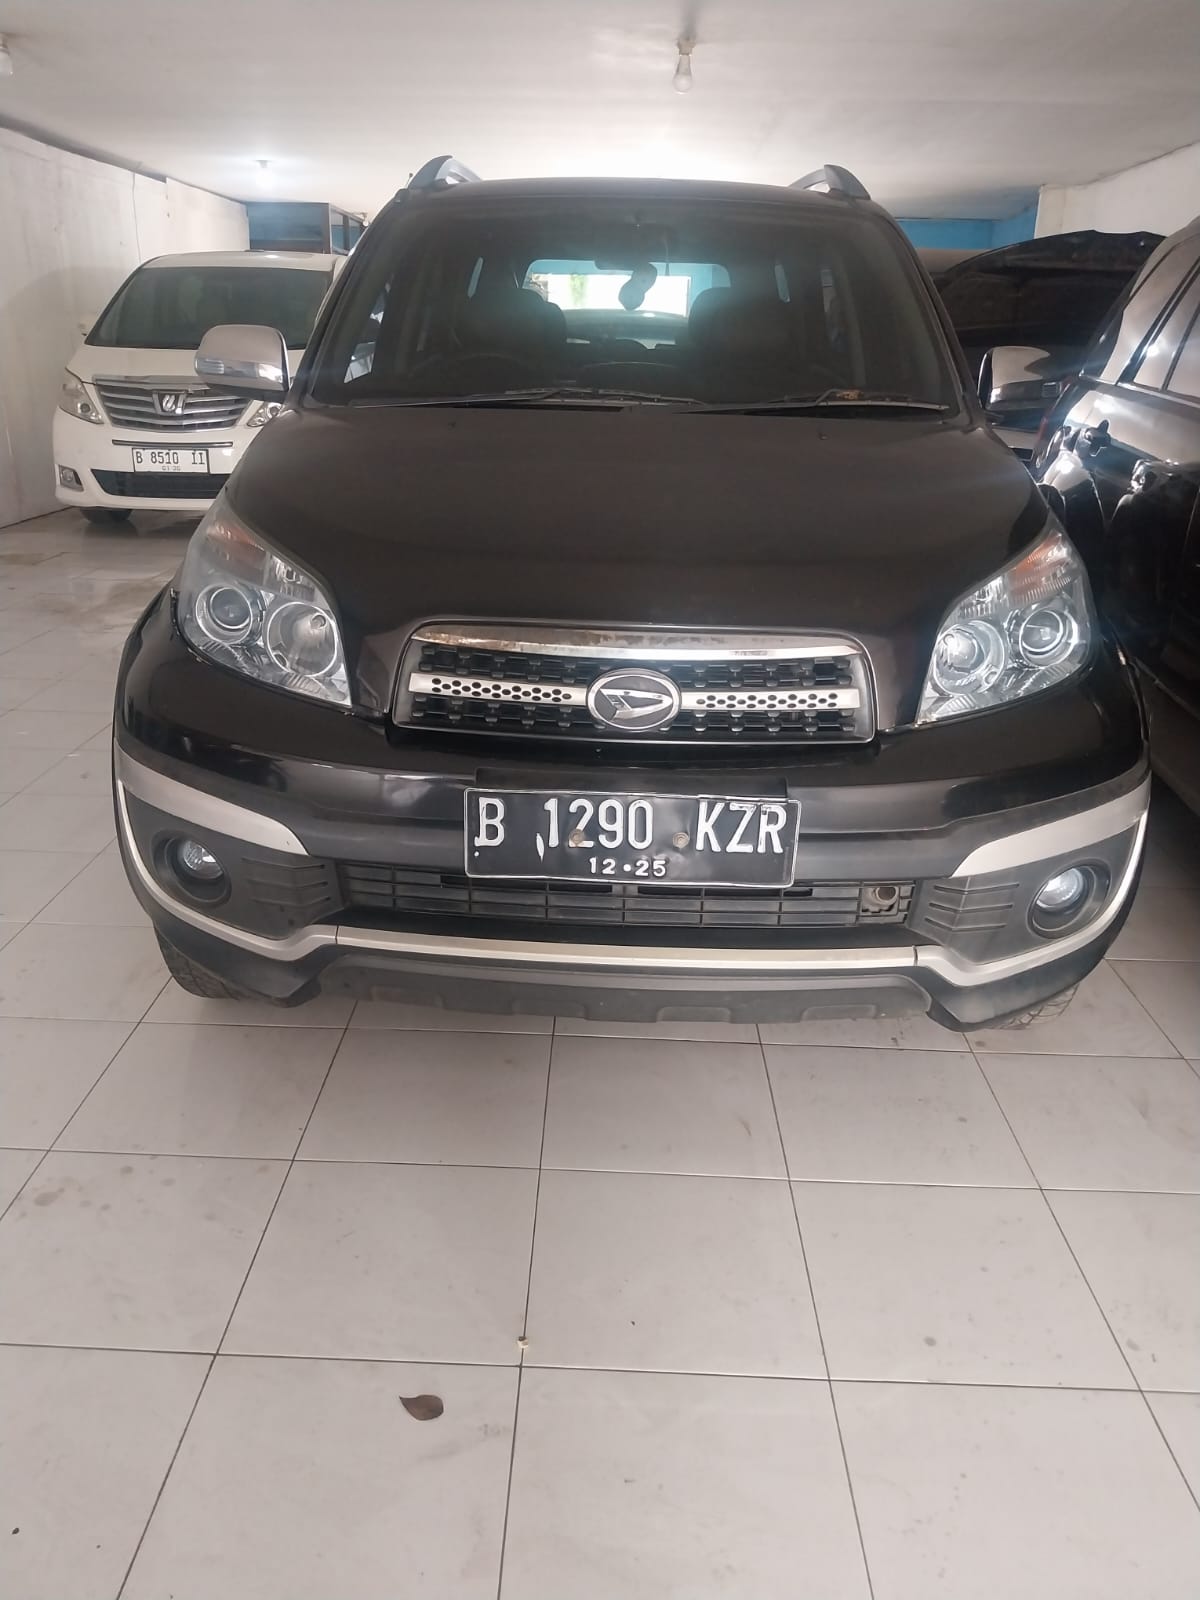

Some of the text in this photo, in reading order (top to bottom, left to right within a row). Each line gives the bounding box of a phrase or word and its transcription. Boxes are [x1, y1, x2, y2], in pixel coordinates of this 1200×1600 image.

[135, 451, 205, 465] B 8510 II
[474, 796, 787, 854] B 1290 KZR
